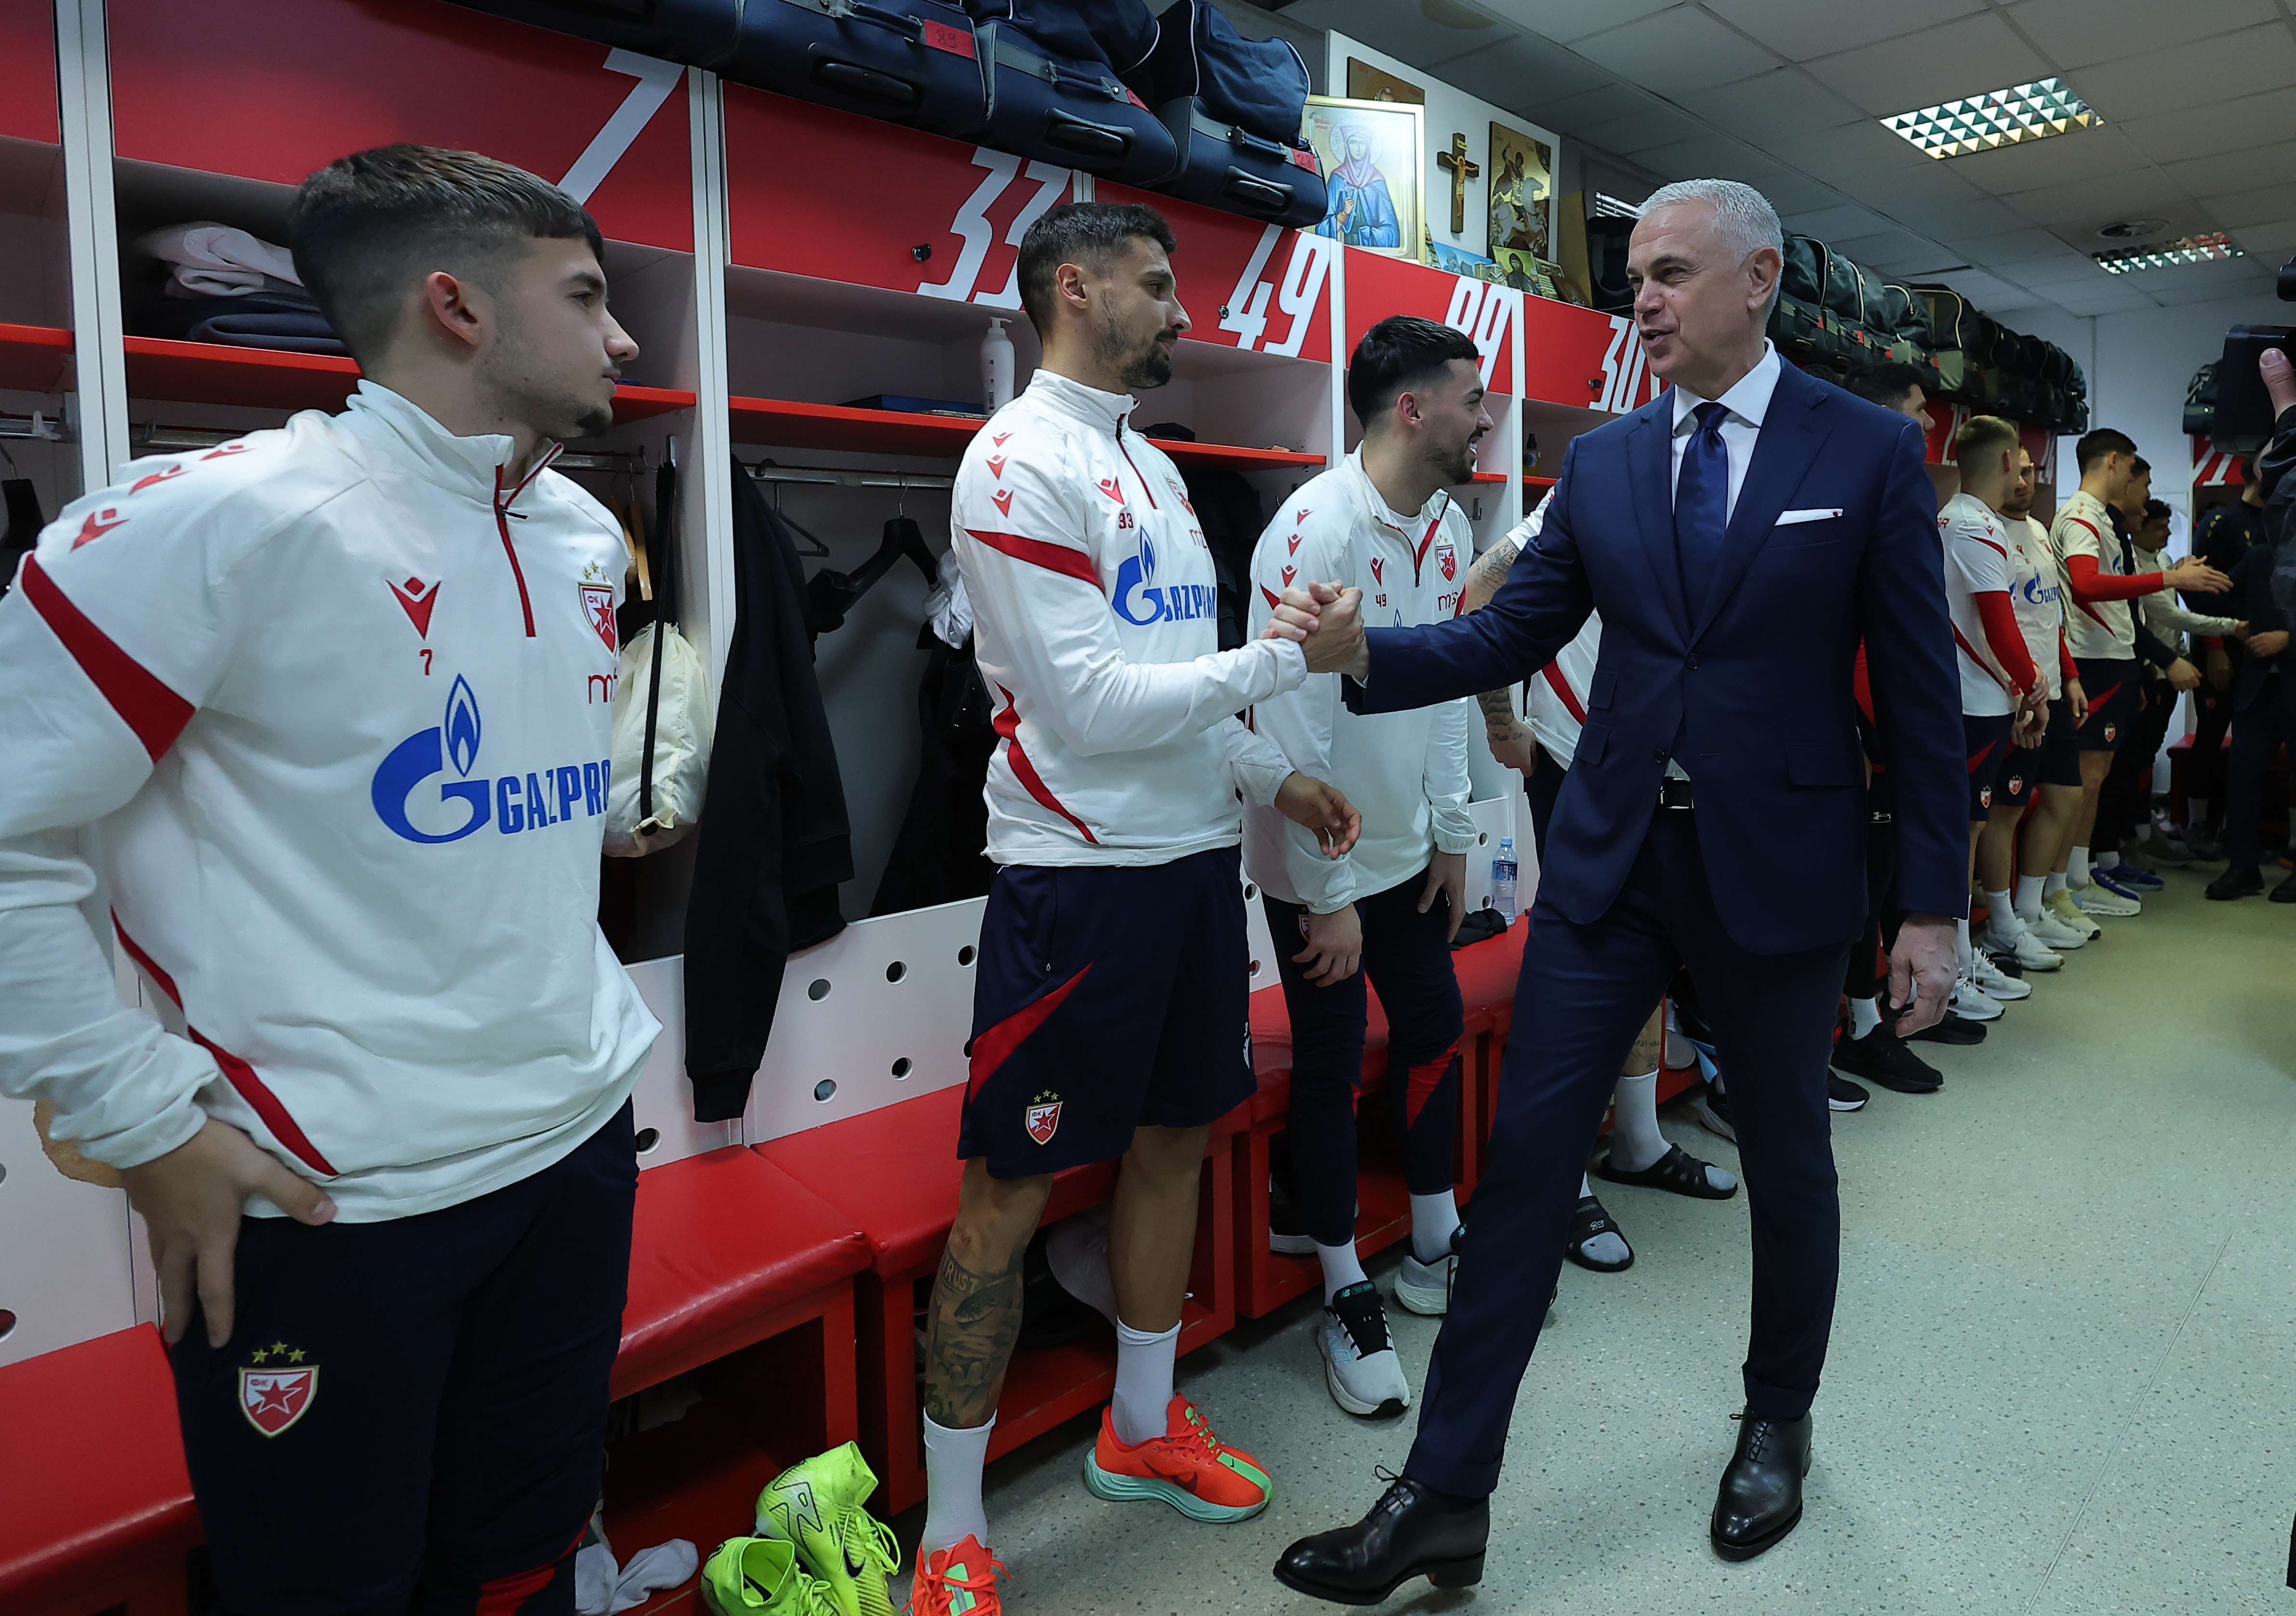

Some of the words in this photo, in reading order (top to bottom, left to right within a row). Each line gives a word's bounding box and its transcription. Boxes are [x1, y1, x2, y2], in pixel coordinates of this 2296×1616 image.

[937, 29, 956, 48] 89
[557, 47, 686, 206] 7
[916, 146, 1072, 310] 33
[1218, 223, 1330, 358] 49
[1589, 315, 1646, 414] 30
[1118, 513, 1133, 529] 33
[1164, 585, 1216, 622] AZPRM
[1375, 593, 1387, 607] 49
[419, 649, 432, 676] 7
[1590, 1220, 1604, 1230] 89
